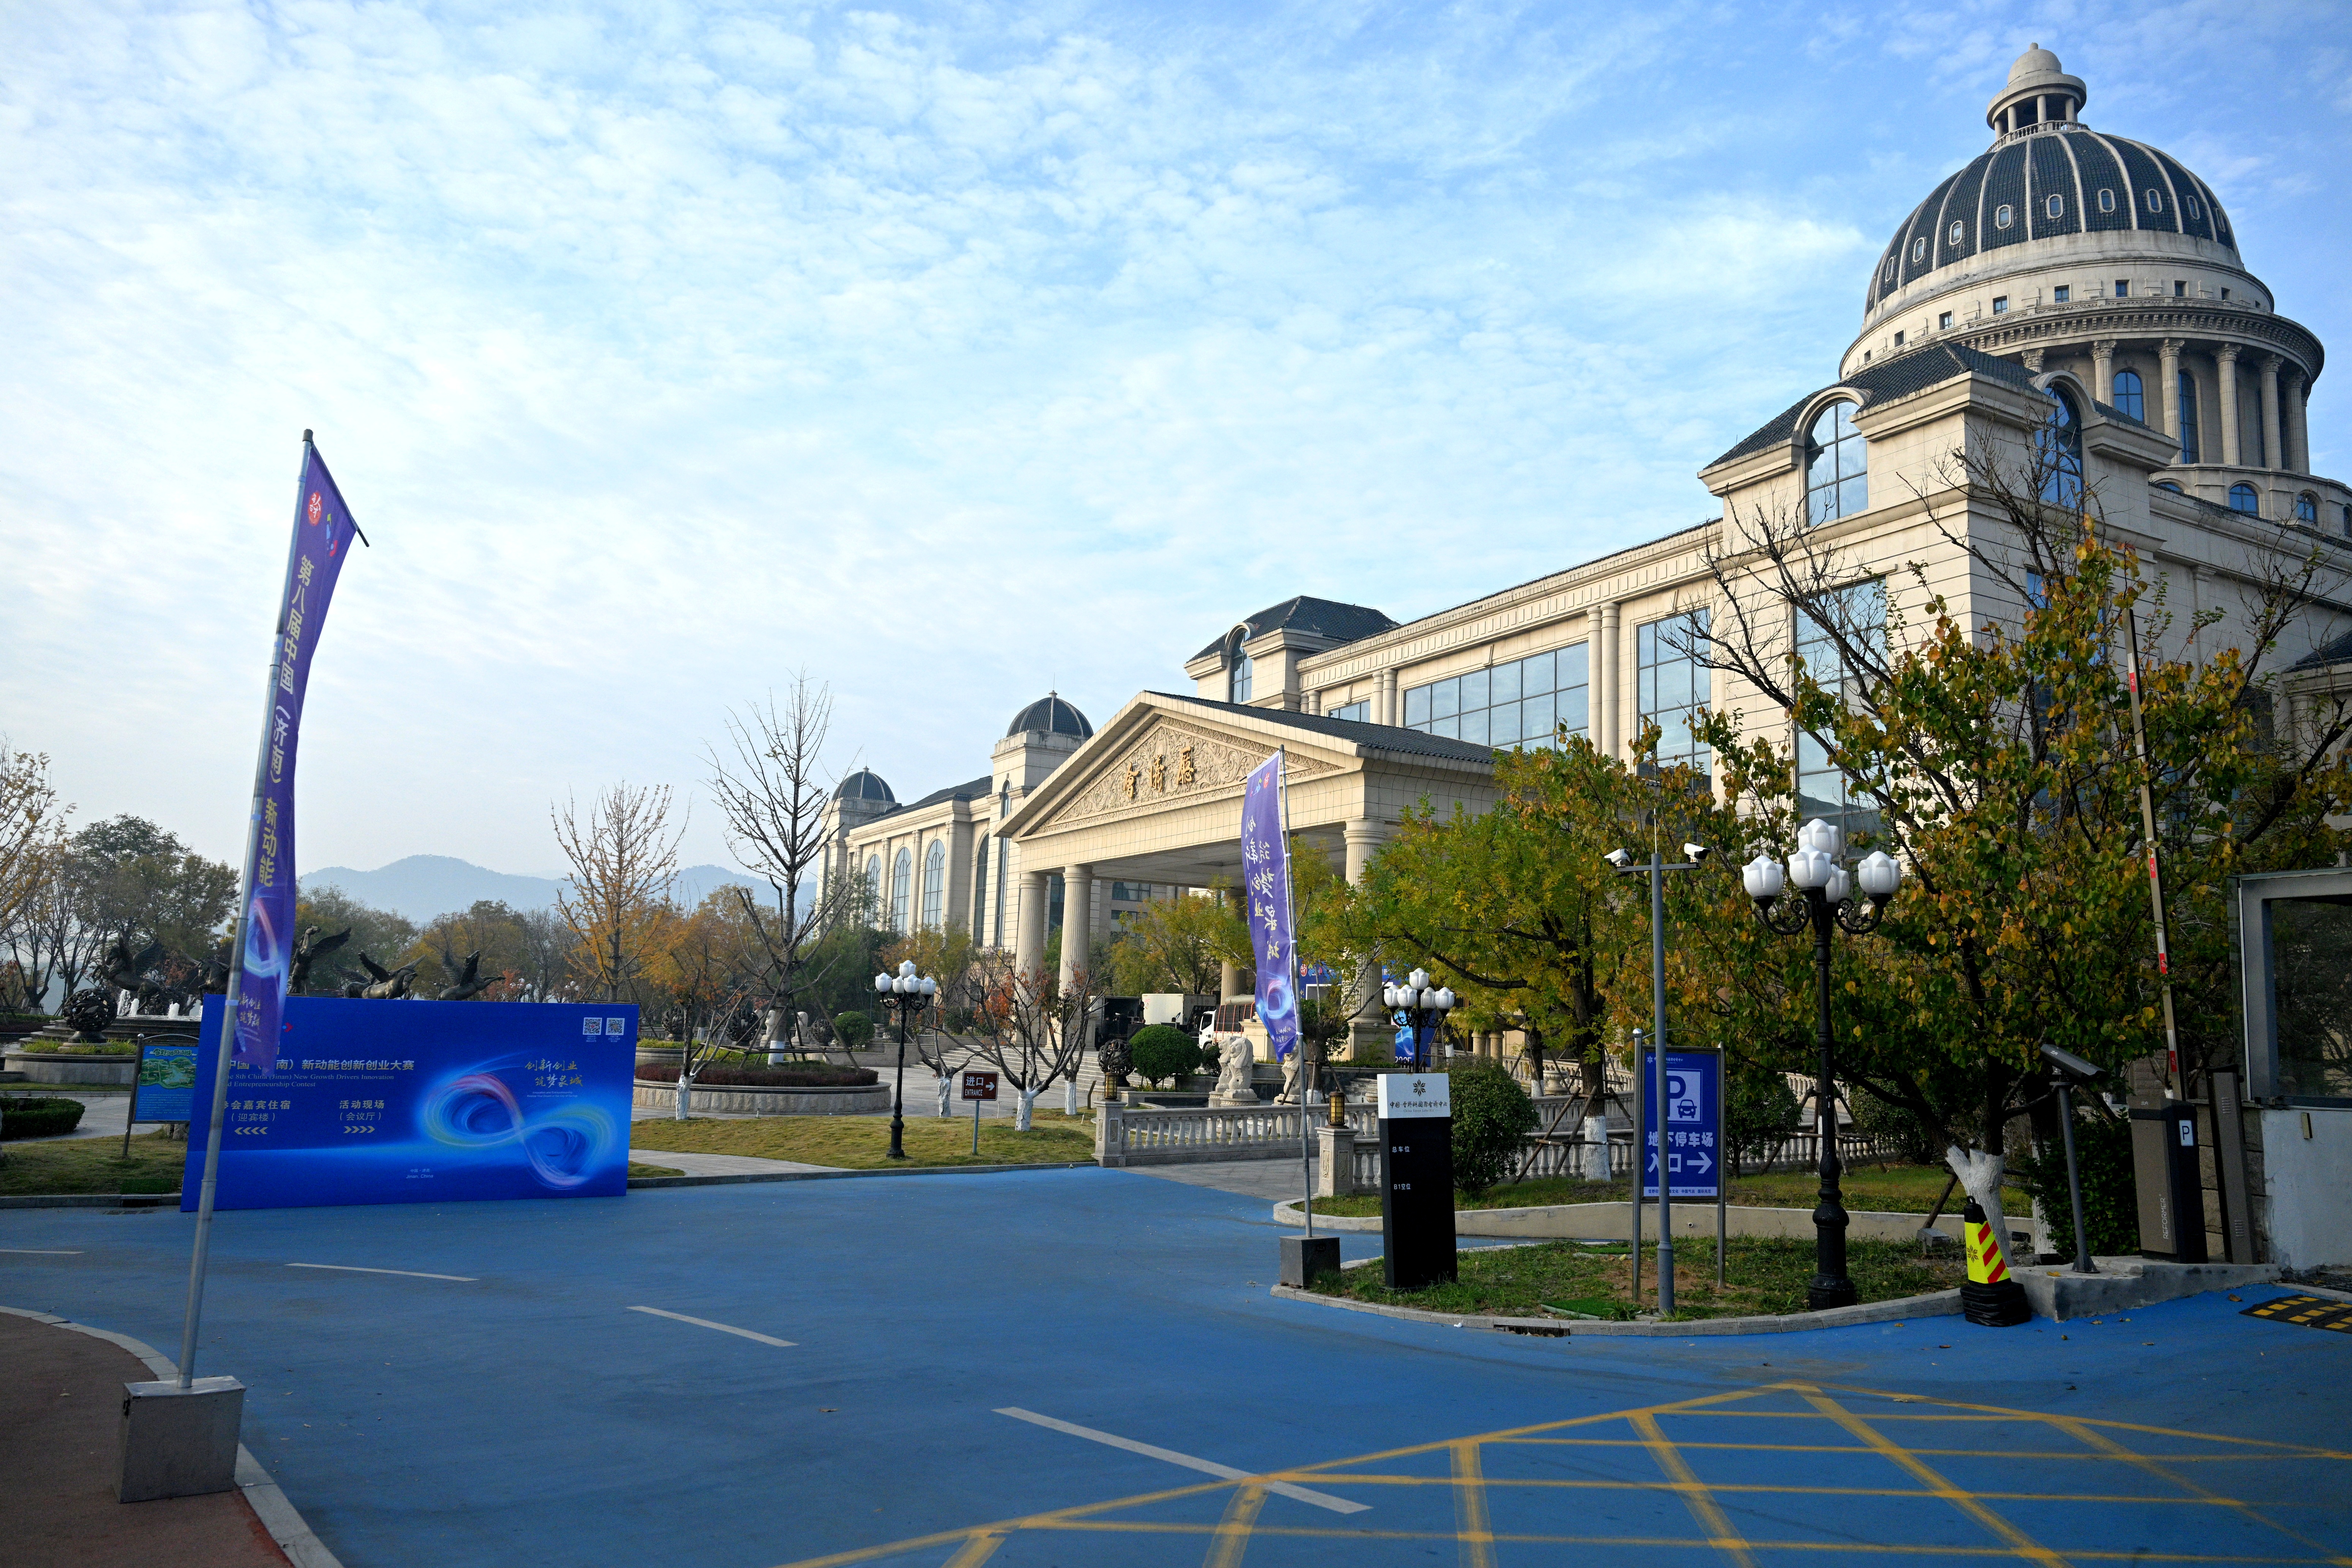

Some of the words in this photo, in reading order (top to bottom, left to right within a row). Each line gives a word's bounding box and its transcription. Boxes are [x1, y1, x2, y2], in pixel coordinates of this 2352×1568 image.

[525, 1059, 577, 1072] 创新创业
[535, 1073, 583, 1088] 筑梦泉城
[966, 1076, 984, 1086] 进口
[339, 1100, 384, 1109] 活动现场
[2182, 1125, 2190, 1140] P
[1648, 1152, 1681, 1173] 入口
